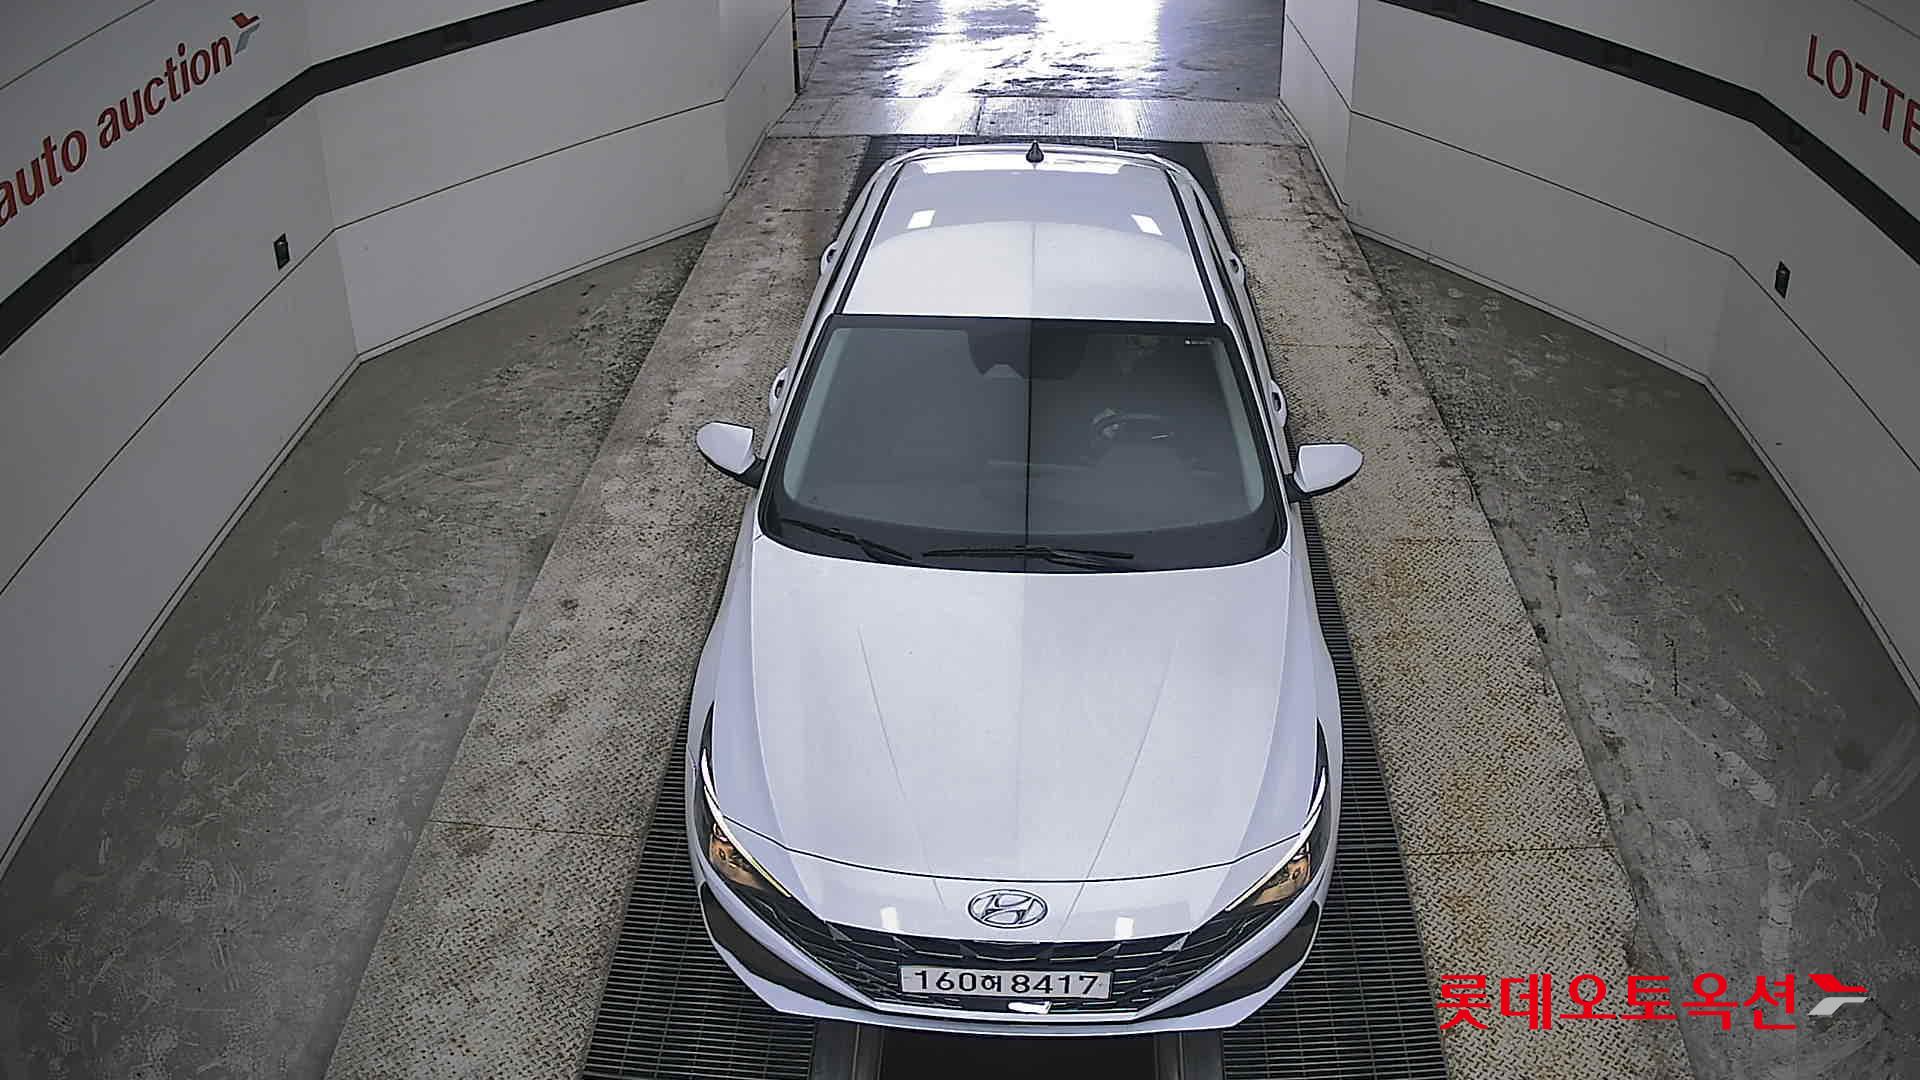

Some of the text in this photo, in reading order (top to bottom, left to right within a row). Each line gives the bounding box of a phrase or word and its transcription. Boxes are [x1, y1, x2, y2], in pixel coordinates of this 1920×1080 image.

[0, 36, 233, 227] auto auction
[1807, 33, 1920, 156] LOTTE
